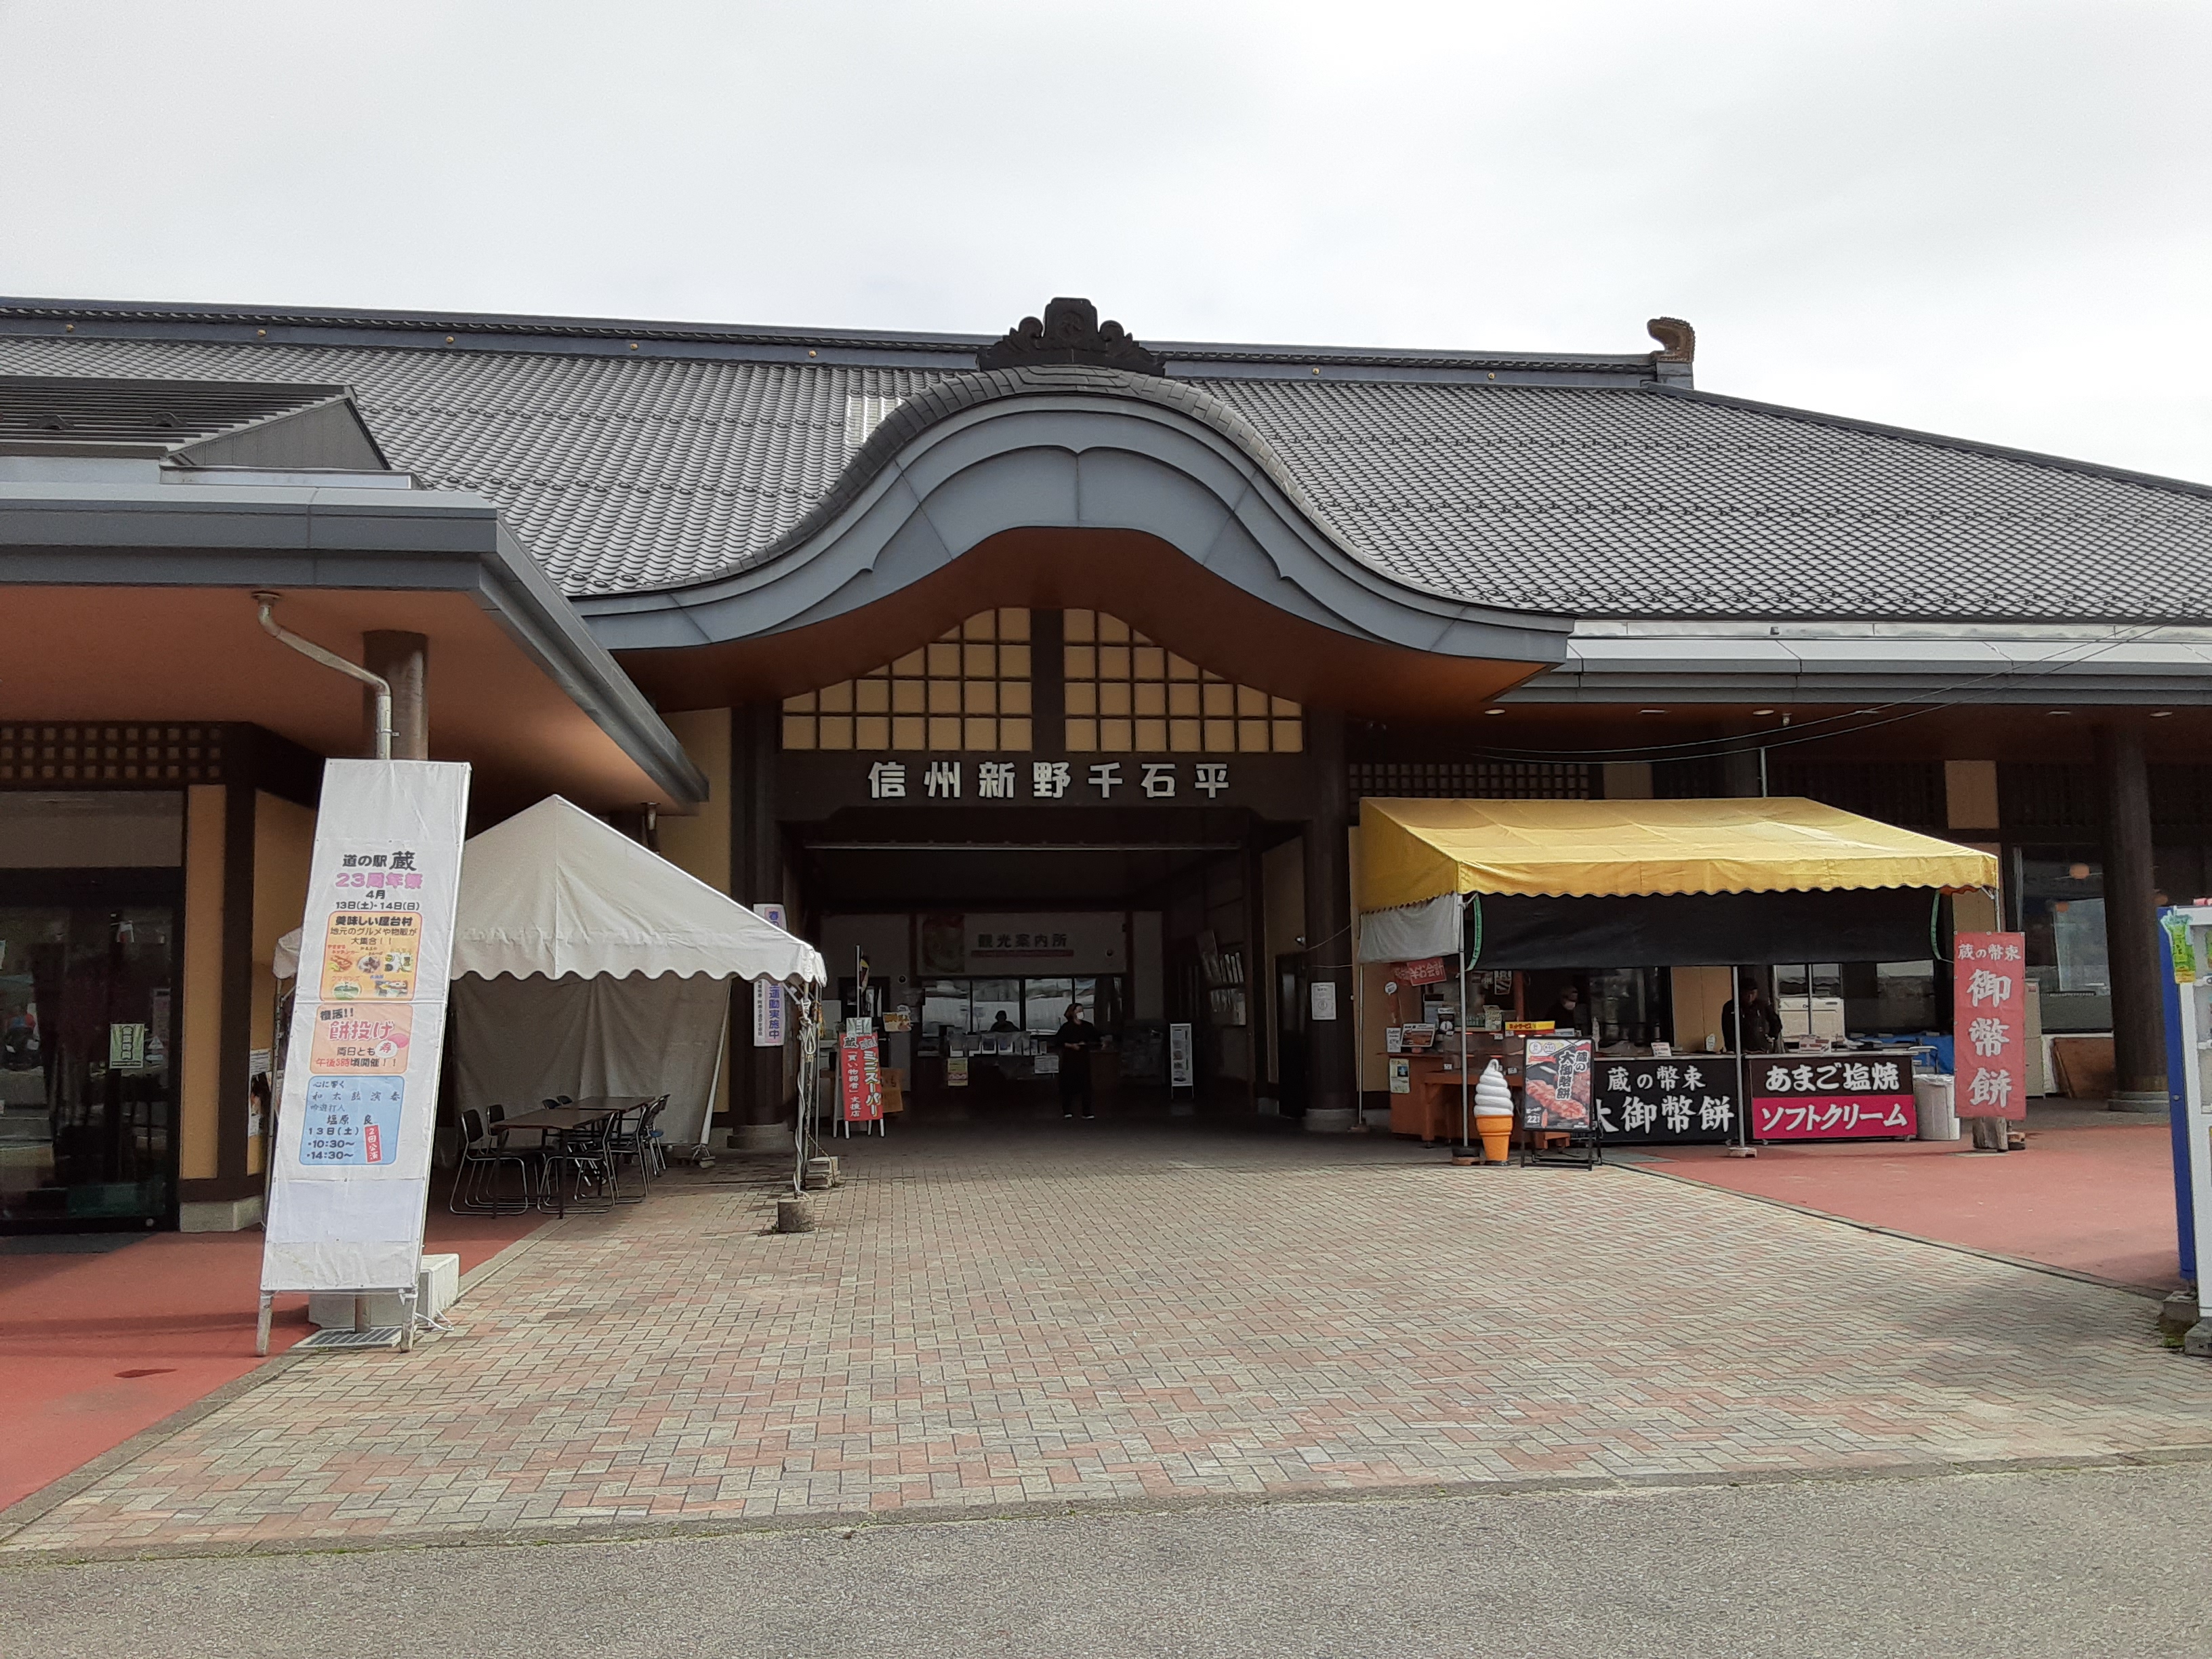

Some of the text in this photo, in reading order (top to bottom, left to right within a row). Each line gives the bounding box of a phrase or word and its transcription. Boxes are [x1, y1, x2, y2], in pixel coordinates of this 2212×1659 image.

[867, 761, 1229, 798] 信州新野千石平
[335, 872, 424, 889] 23周年祭
[365, 889, 386, 900] 4月
[335, 916, 413, 926] 美味しい屋台村
[977, 933, 1068, 948] 観光案内所
[1957, 943, 2022, 962] 蔵の幣束
[329, 1020, 394, 1040] 餅投げ
[1966, 968, 2012, 1109] 御幣餅
[337, 1047, 375, 1056] 両日とも
[863, 1050, 881, 1117] ミニスーパー
[1606, 1065, 1706, 1092] 蔵の幣束
[1765, 1062, 1900, 1092] あまご塩焼
[1761, 1103, 1908, 1132] ソフトクリーム
[367, 1128, 379, 1160] 2回公演
